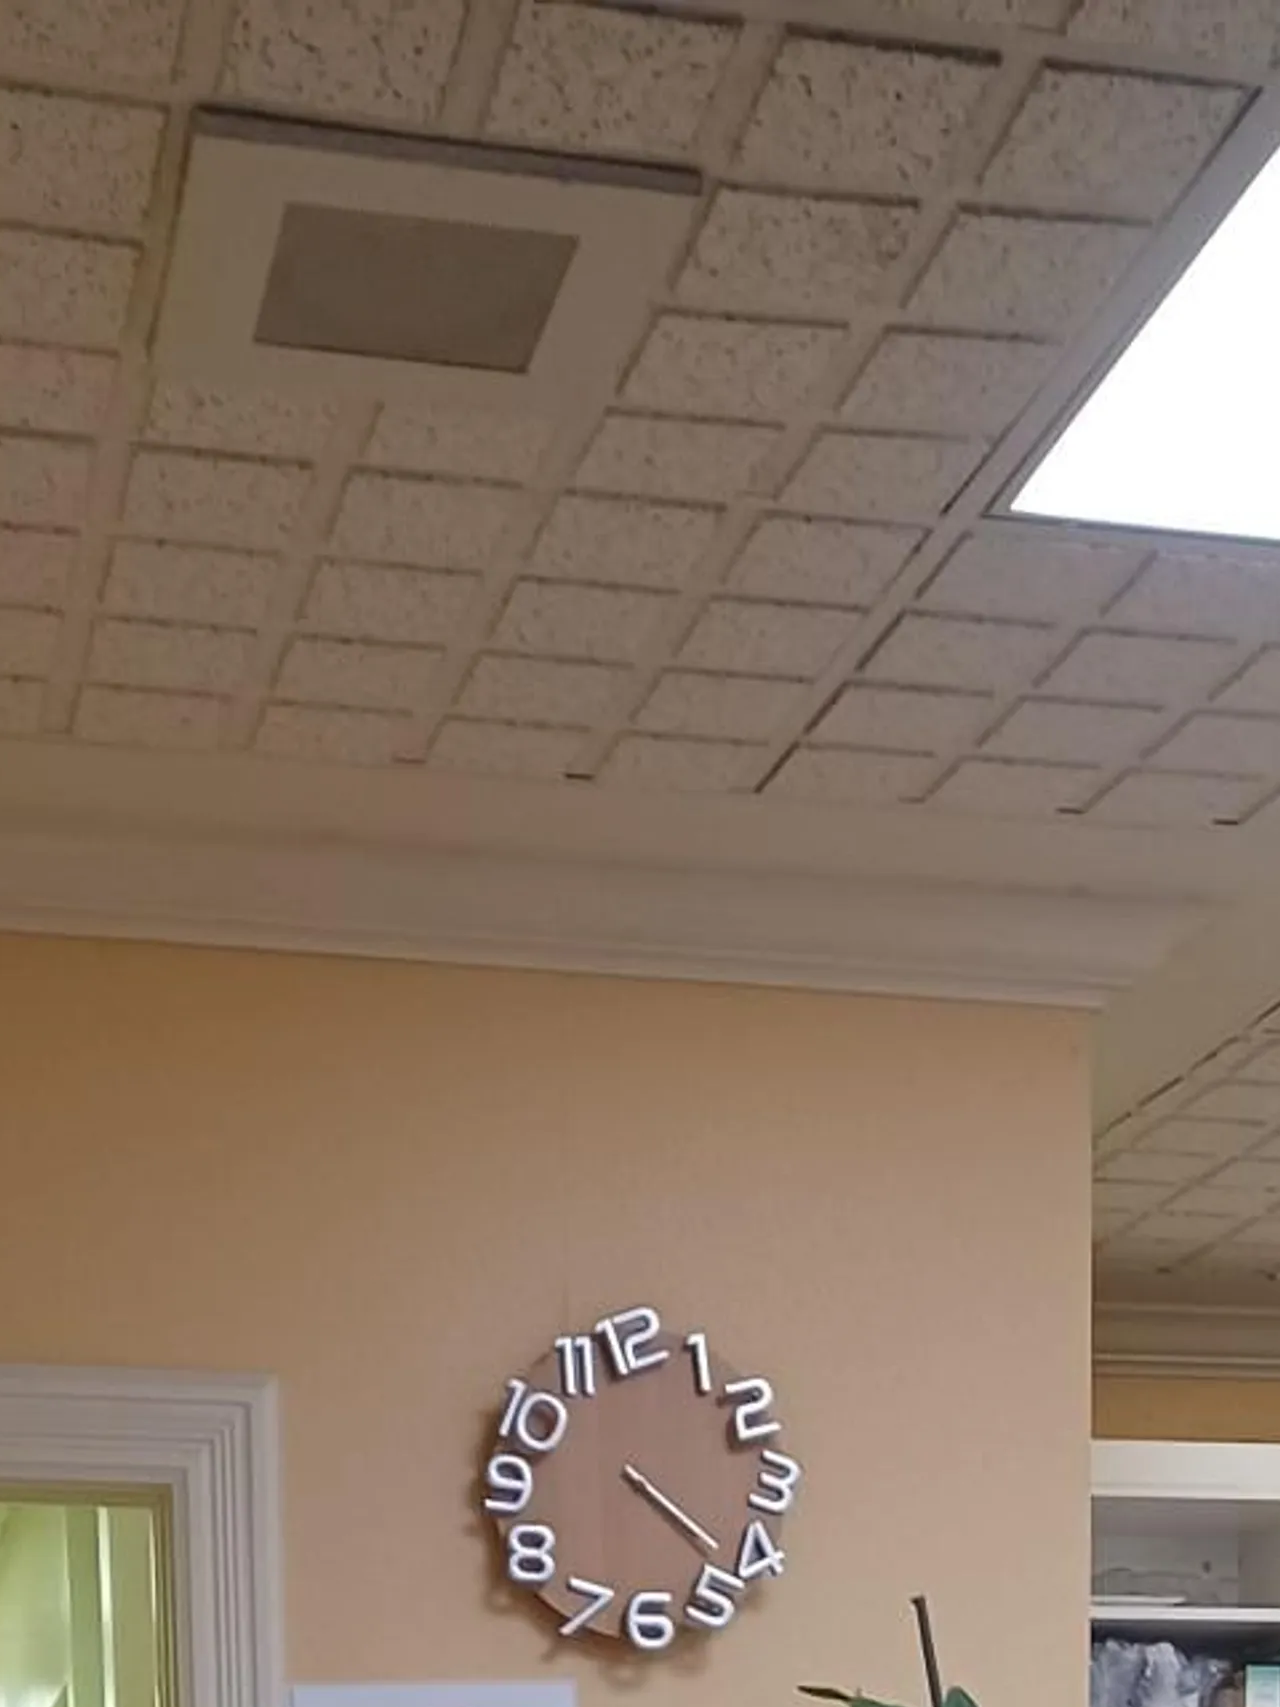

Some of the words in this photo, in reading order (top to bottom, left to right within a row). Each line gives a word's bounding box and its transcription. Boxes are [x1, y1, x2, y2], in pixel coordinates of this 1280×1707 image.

[555, 1336, 596, 1396] 11
[595, 1306, 669, 1376] 12
[686, 1332, 711, 1393] 1
[500, 1379, 568, 1453] 10
[724, 1378, 782, 1441] 2
[484, 1454, 532, 1513] 9
[749, 1450, 802, 1513] 3
[508, 1524, 556, 1581] 8
[737, 1520, 786, 1579] 4
[558, 1576, 615, 1636] 7
[627, 1591, 675, 1649] 6
[685, 1564, 746, 1627] 5
